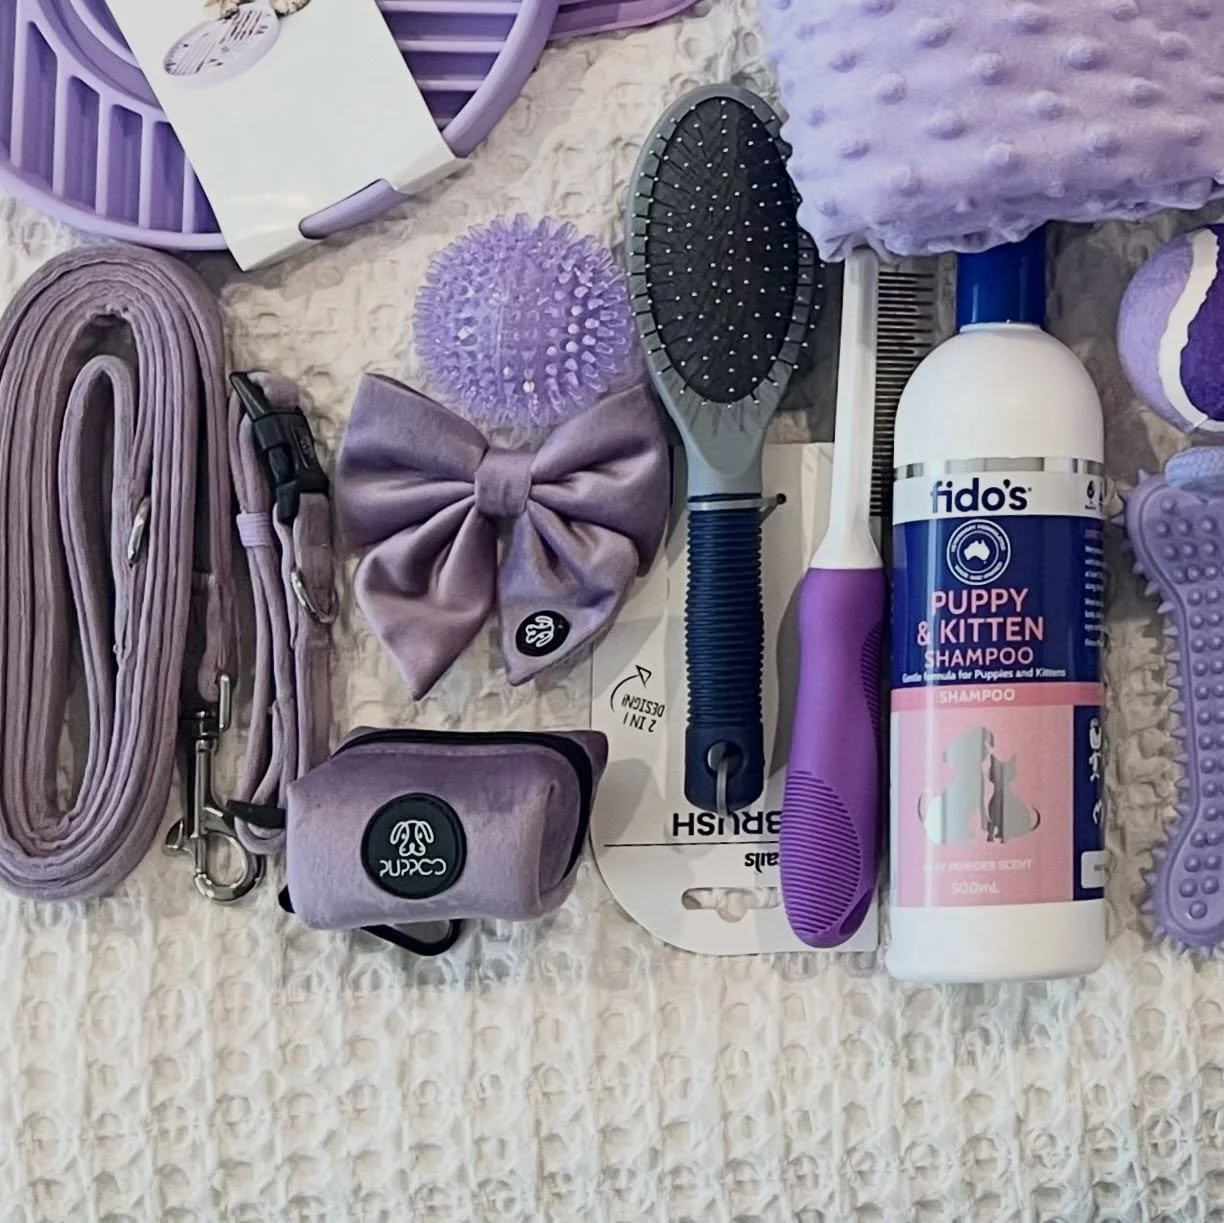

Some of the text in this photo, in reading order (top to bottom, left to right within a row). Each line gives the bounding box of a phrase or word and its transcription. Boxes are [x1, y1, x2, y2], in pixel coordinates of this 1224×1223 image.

[931, 477, 1028, 514] fido's
[931, 587, 1029, 617] PUPPY
[917, 616, 1044, 646] & KITTEN
[925, 646, 1034, 669] SHAMPOO
[974, 668, 1014, 681] Puppies
[1015, 668, 1034, 679] and
[939, 688, 1016, 705] SHAMPOO
[629, 717, 647, 730] IN
